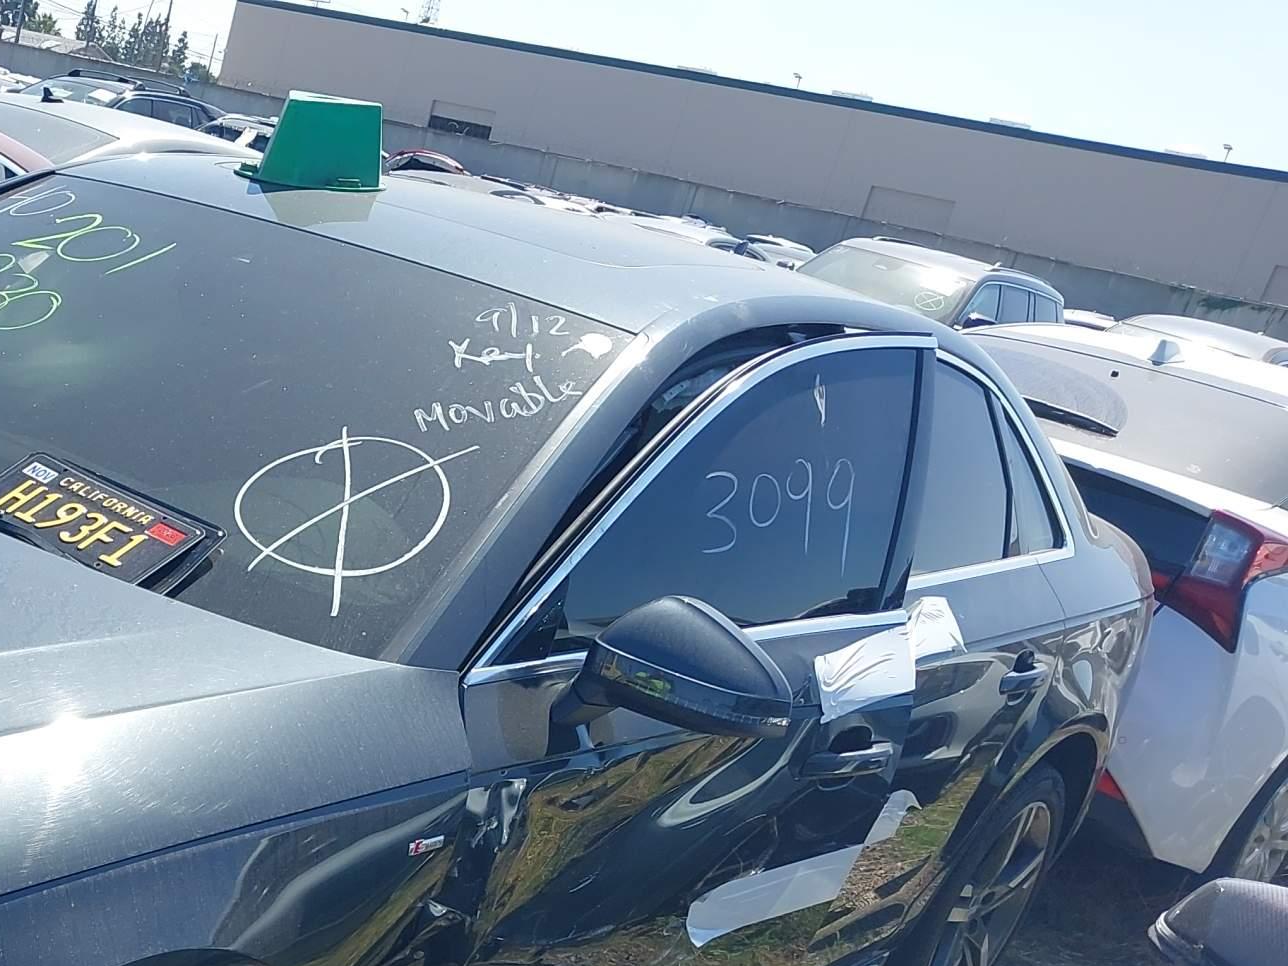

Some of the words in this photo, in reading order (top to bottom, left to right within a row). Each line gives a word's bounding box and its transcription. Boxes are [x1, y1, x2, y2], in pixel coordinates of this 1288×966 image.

[28, 464, 57, 482] NOV
[59, 476, 155, 526] CALIFORNIA
[701, 457, 856, 578] 3099
